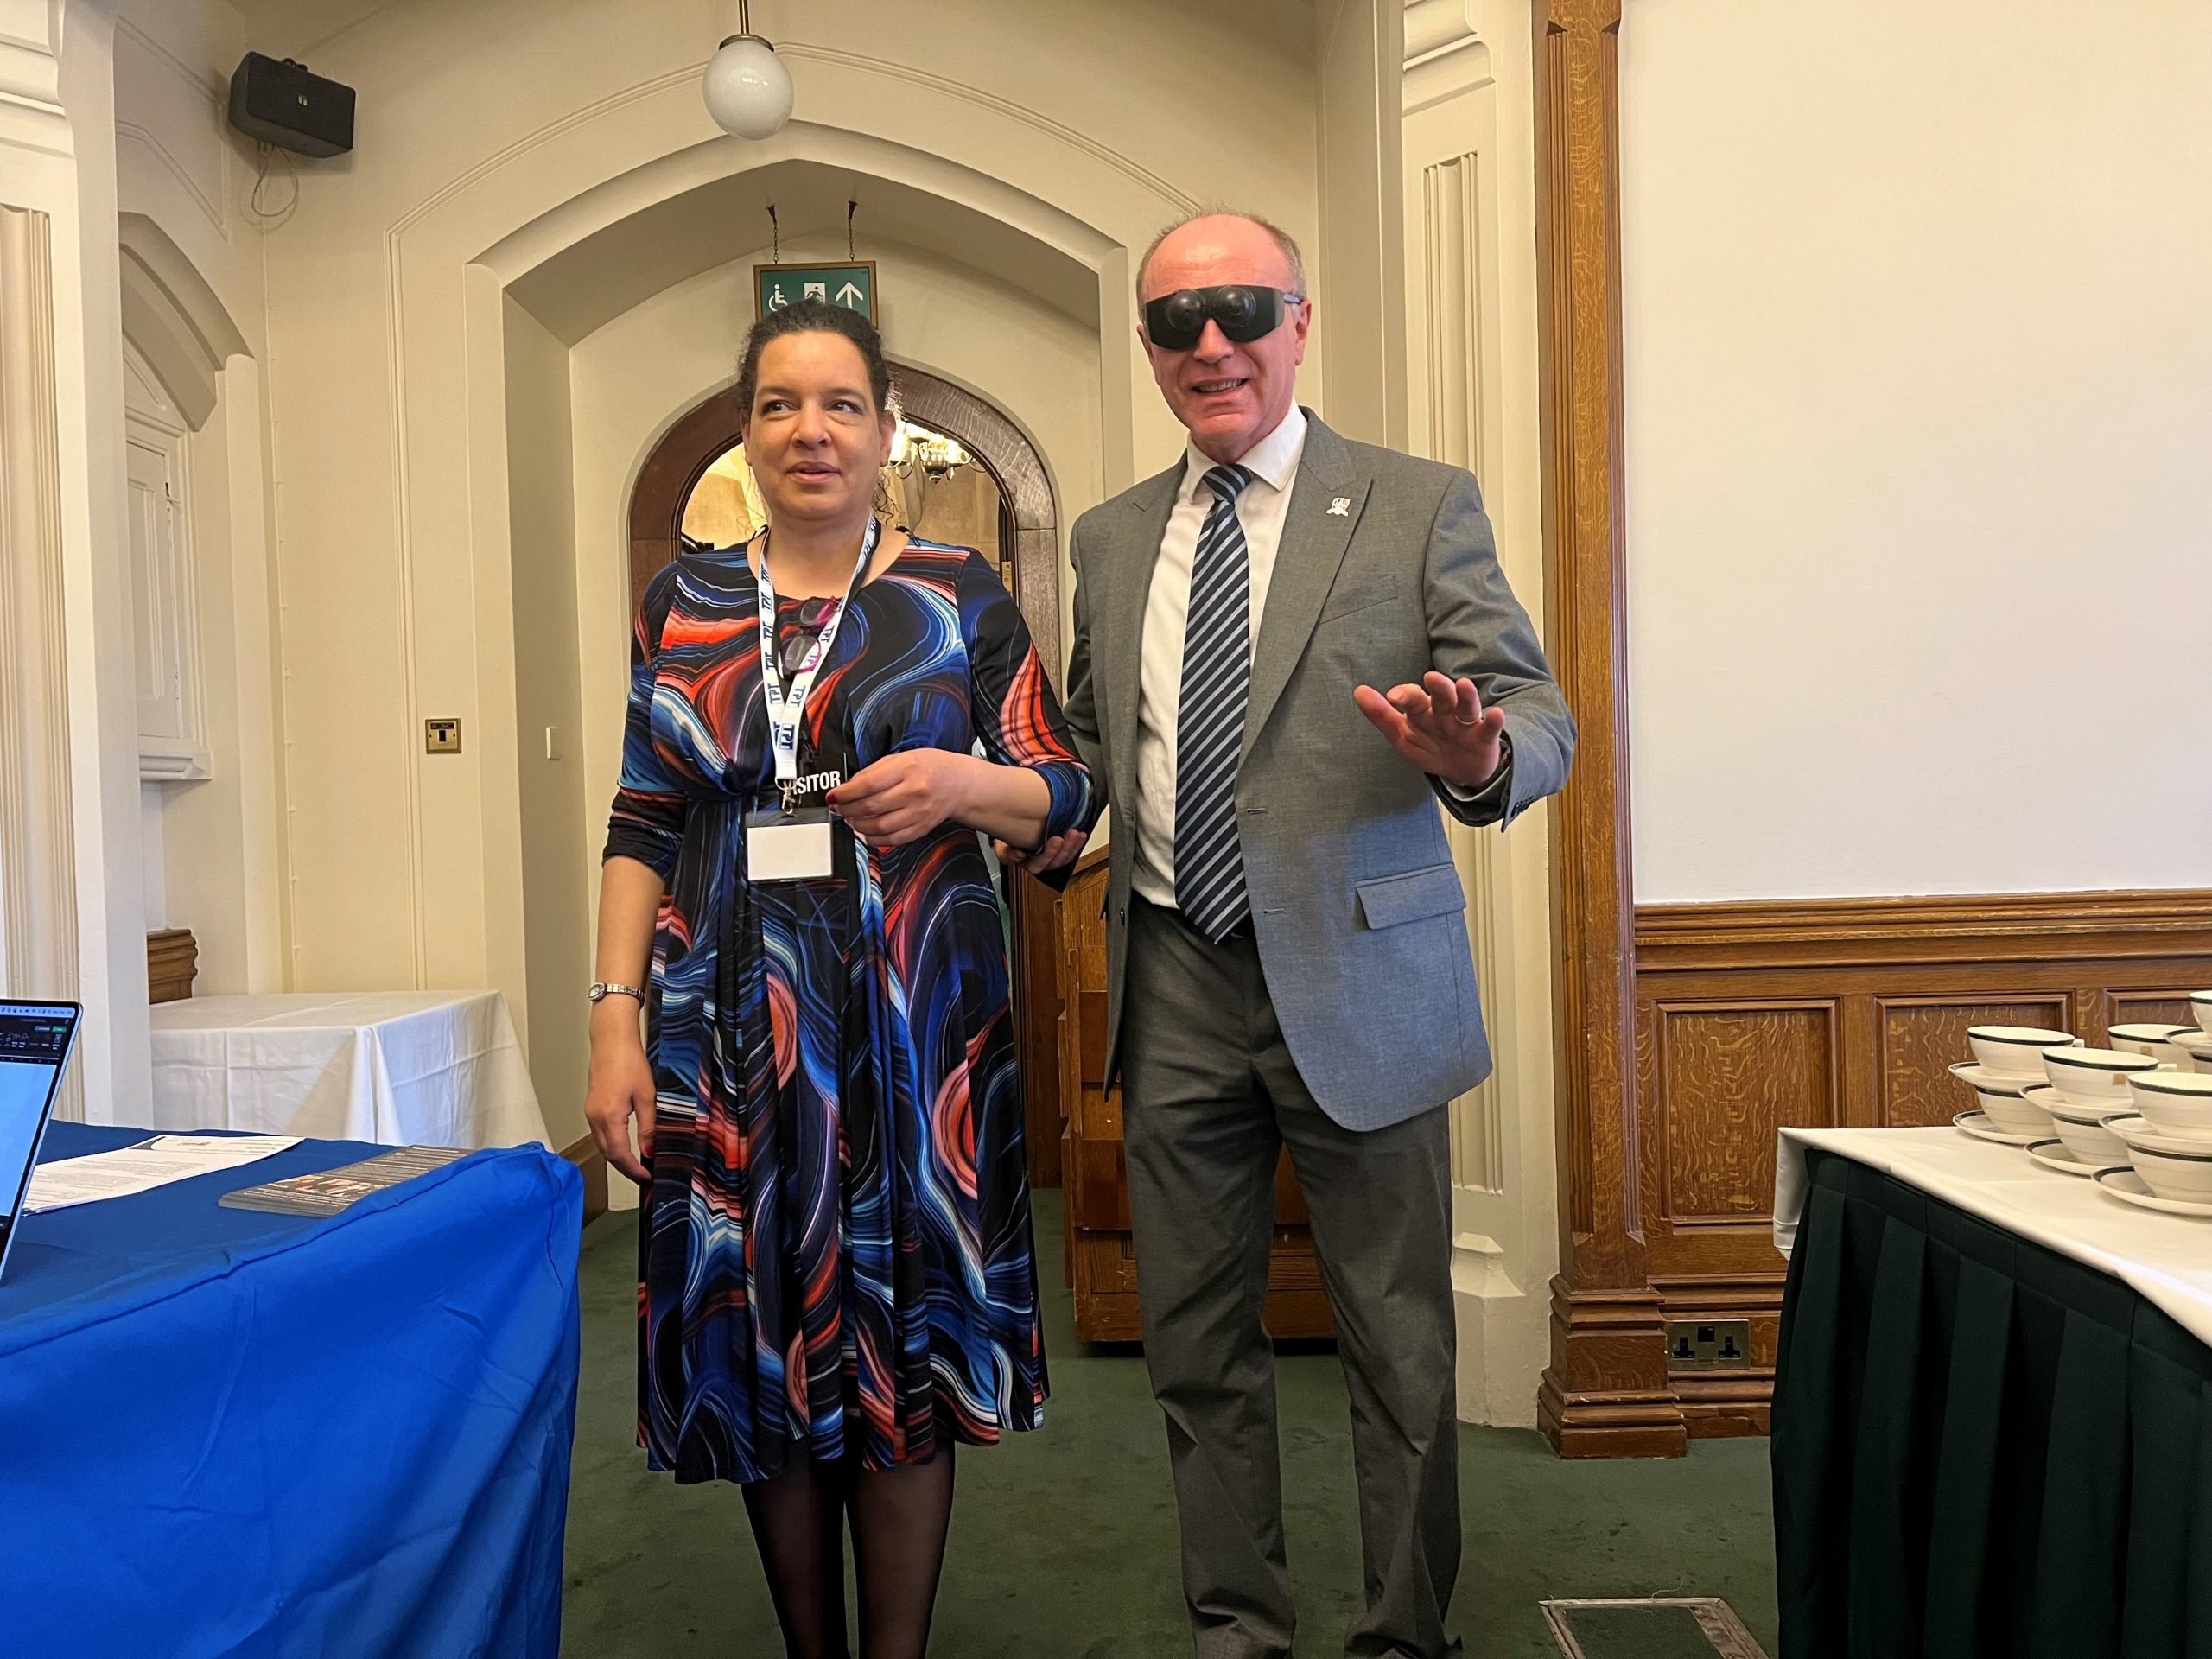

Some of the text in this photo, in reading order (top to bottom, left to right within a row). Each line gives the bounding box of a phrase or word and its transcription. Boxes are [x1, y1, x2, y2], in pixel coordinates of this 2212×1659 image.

[760, 591, 772, 611] TPT
[763, 621, 773, 639] TPT
[821, 625, 836, 643] TPT
[767, 683, 781, 704] TPT
[790, 686, 806, 707] TPT
[779, 724, 795, 750] TPT
